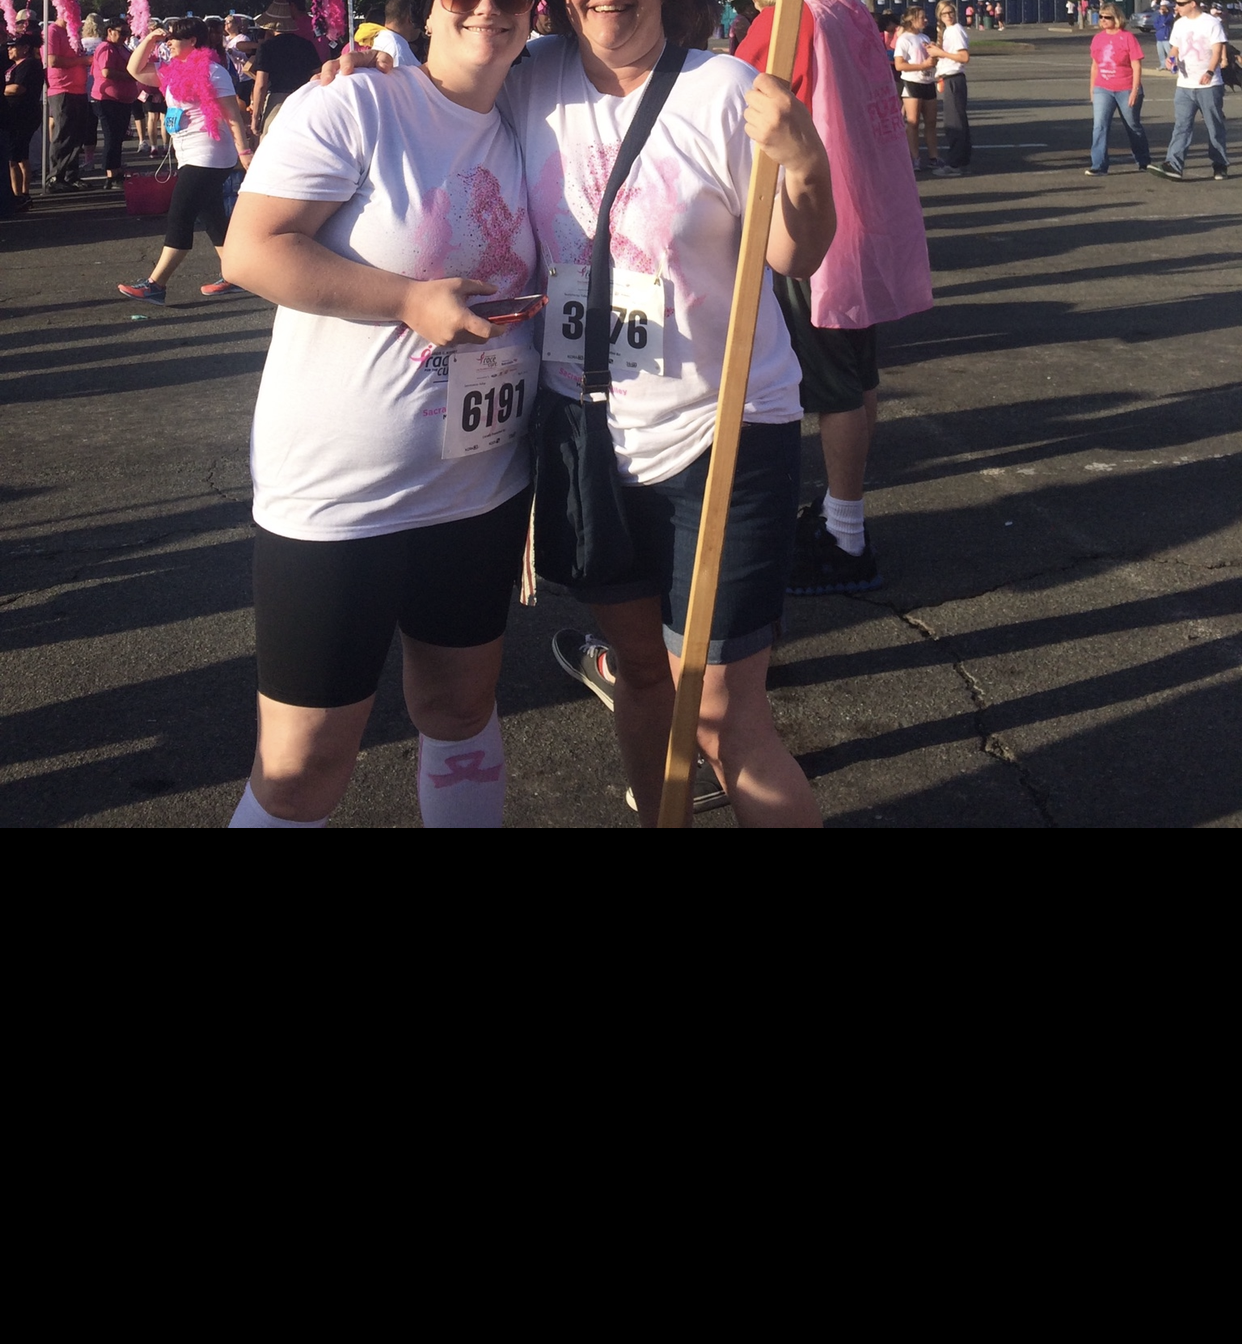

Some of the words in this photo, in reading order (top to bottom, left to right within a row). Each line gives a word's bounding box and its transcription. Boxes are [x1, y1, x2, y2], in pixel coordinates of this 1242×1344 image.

[562, 300, 648, 350] 376
[425, 356, 449, 368] rac
[558, 367, 583, 382] Sacra
[422, 406, 447, 417] Sacra
[462, 379, 525, 432] 6191
